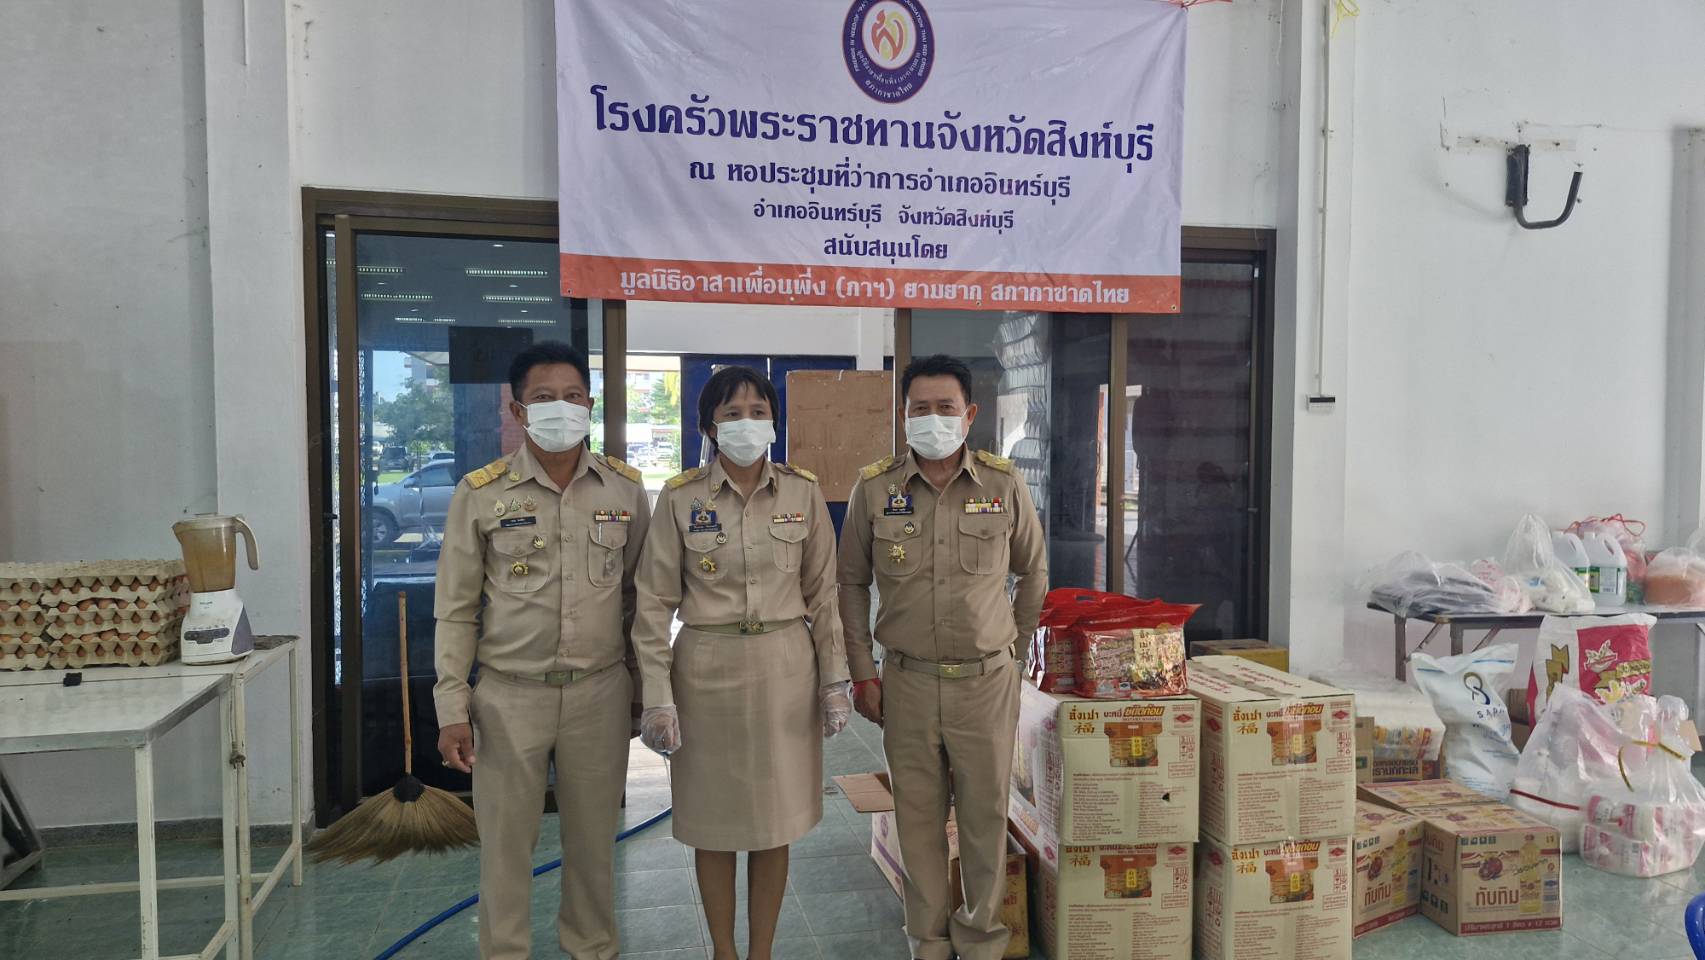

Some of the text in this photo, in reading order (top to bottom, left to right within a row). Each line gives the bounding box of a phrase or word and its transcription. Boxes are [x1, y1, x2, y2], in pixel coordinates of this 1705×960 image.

[590, 84, 1154, 173] โรงครัวพระราชทานจังหวัดสิงห์บุรี
[690, 157, 1071, 205] ณ หอประชุมที่ว่าการอำเภออินทร์บุรี
[753, 198, 1014, 234] อำเภออินทร์บุรี จังหวัดสิงห์บุรี
[824, 233, 948, 264] สนับสนุนโดย
[620, 266, 1129, 304] มูลนิธิอาสาเพื่อนพึ่ง (ภาฯ) ยามยาก สภากาชาดไทย
[1364, 882, 1391, 906] ทับทิม
[1475, 886, 1519, 906] ทับทิม
